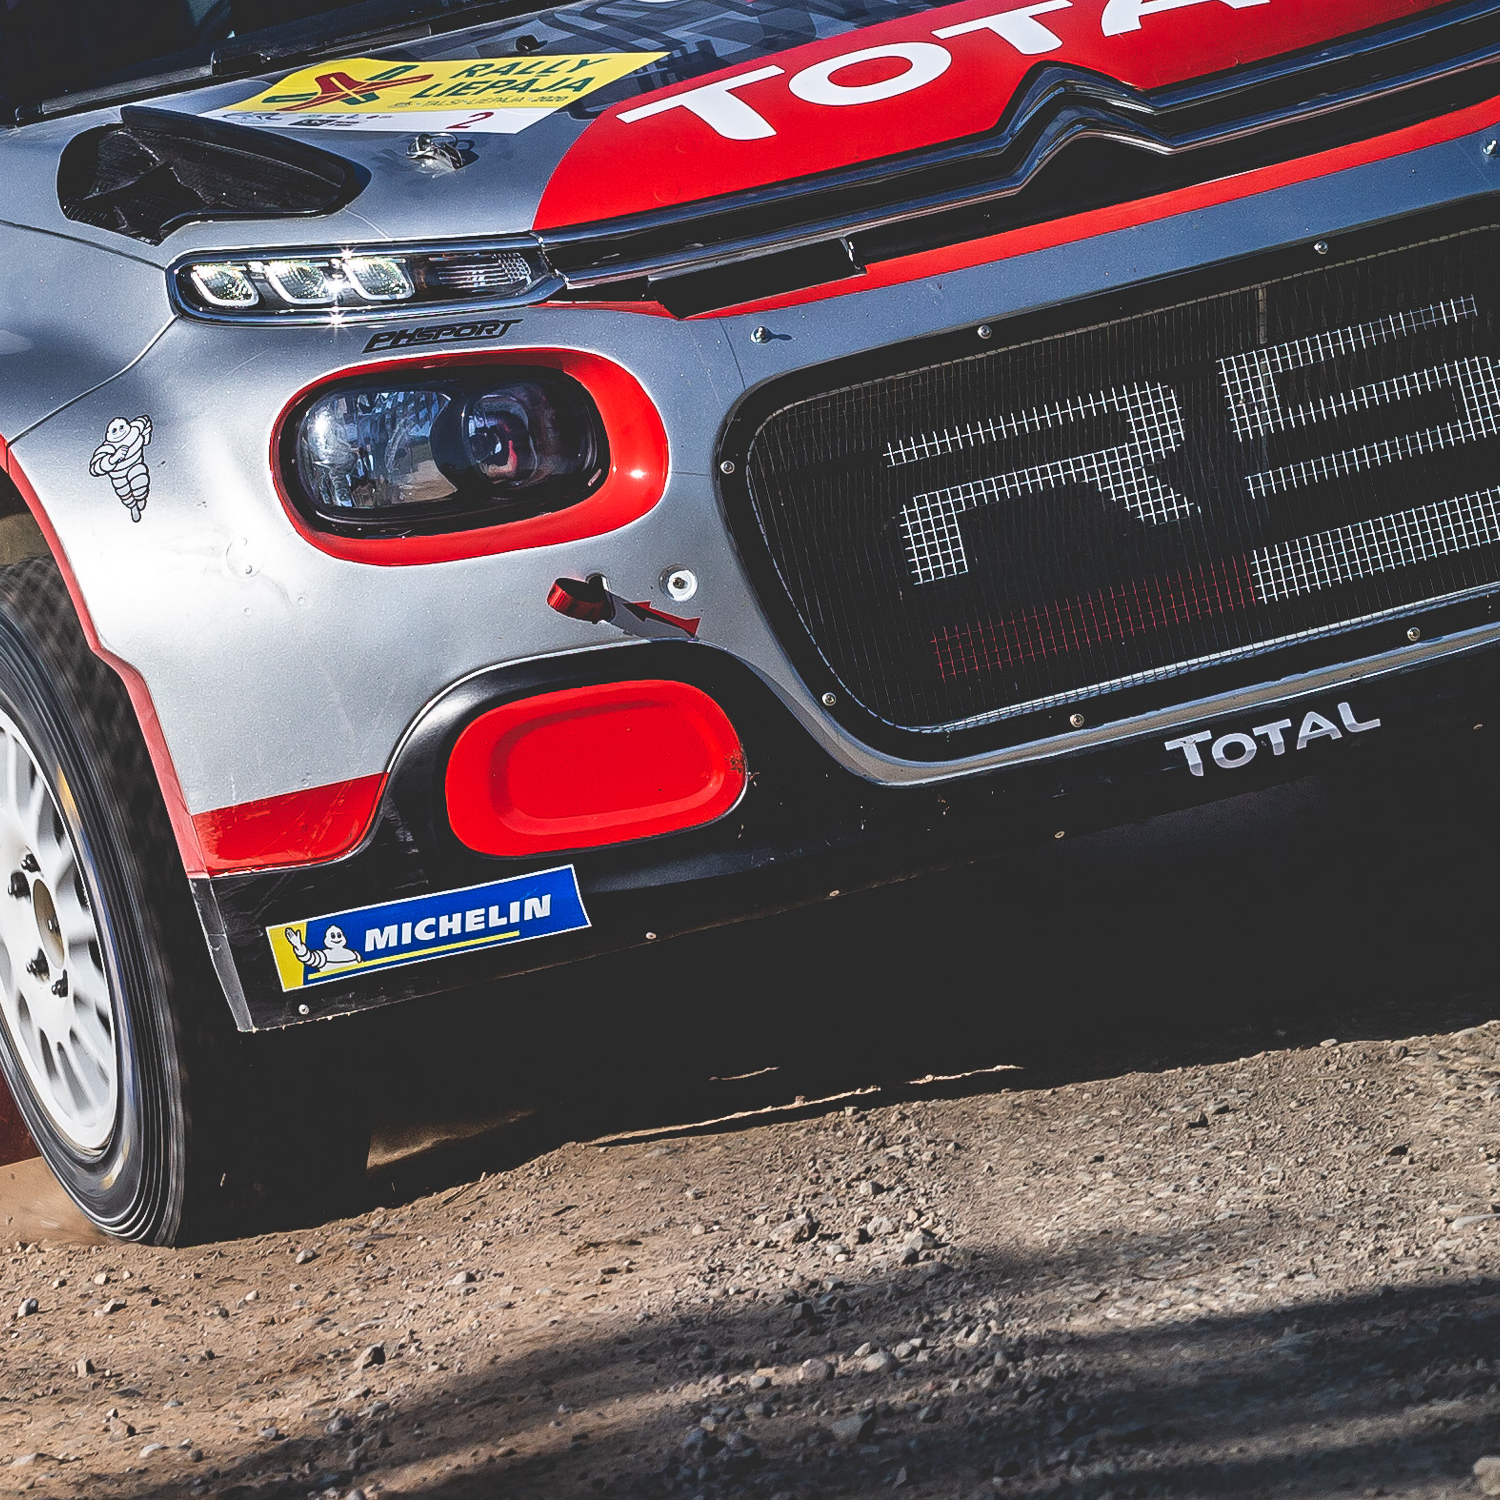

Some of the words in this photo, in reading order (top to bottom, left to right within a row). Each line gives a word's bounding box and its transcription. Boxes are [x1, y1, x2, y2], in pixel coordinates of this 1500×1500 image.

[449, 57, 612, 80] RALLY
[445, 111, 495, 130] 2
[1164, 701, 1382, 777] TOTAL
[365, 893, 551, 952] MICHELIN
